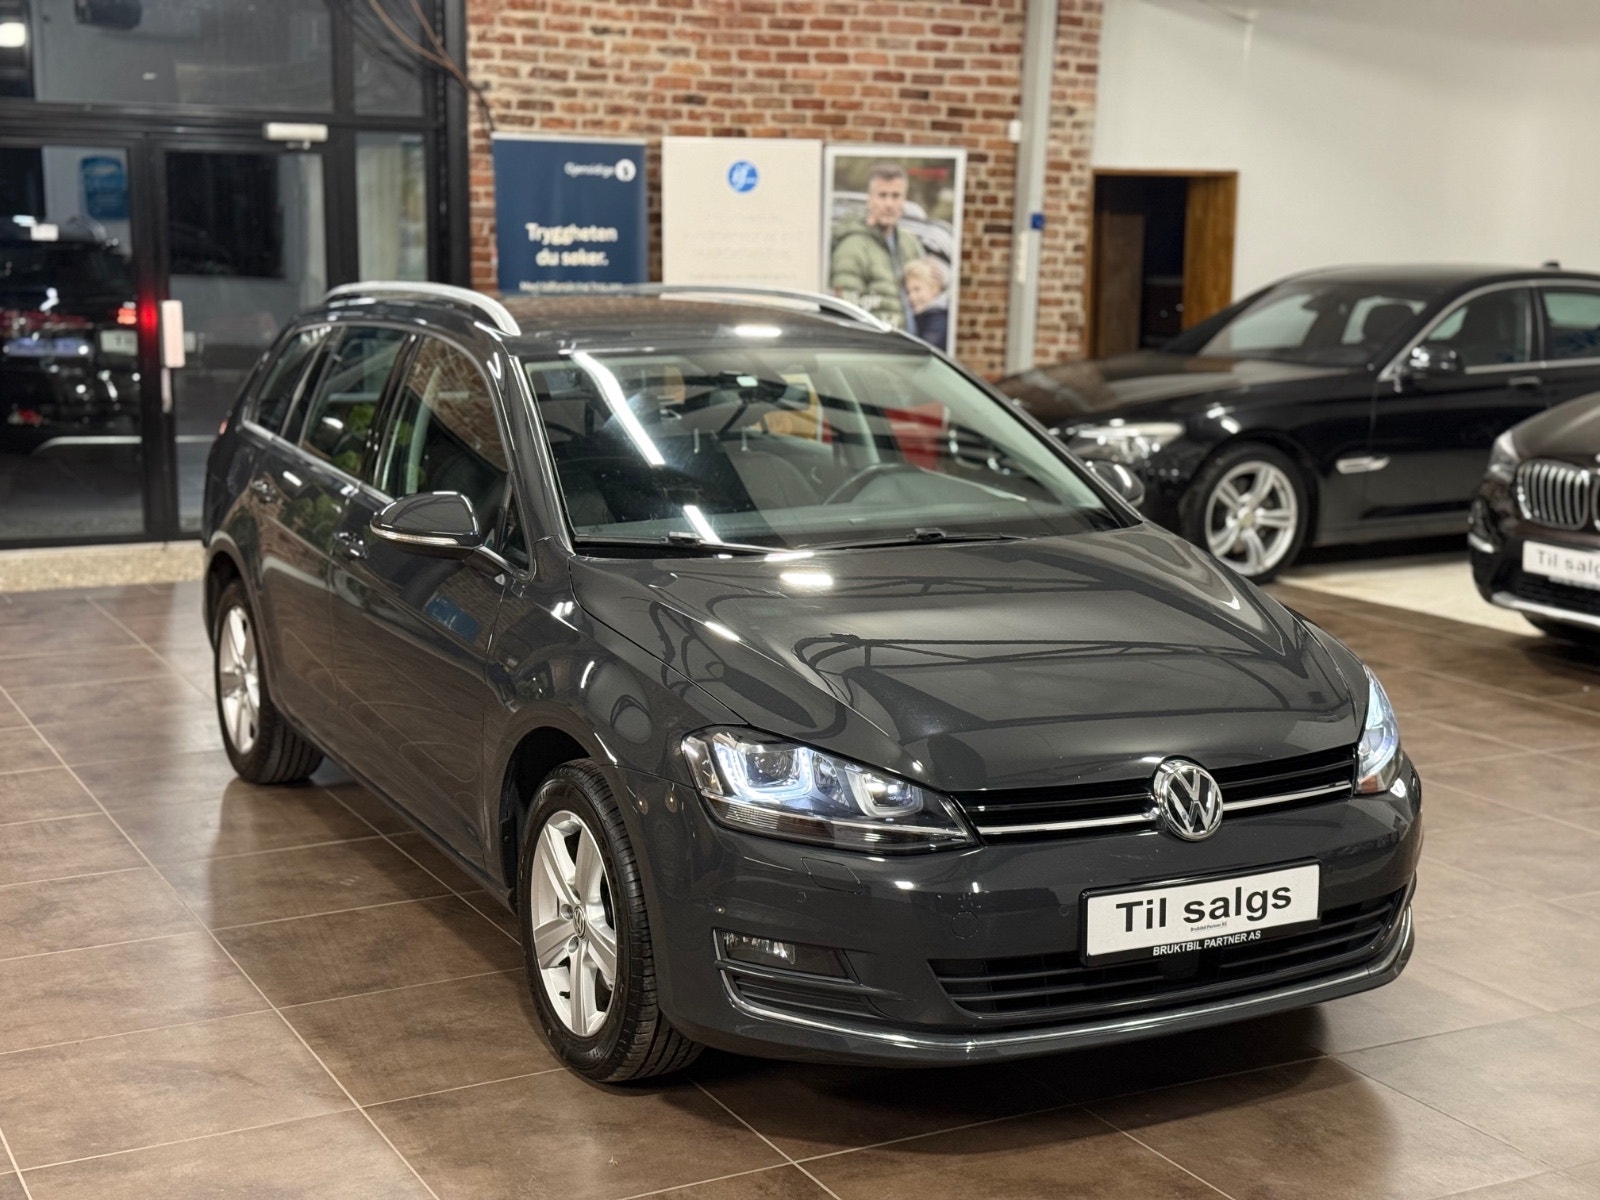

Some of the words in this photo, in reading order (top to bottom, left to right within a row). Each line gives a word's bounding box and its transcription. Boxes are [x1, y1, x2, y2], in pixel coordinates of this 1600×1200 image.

[525, 222, 619, 246] Tryggheten
[535, 248, 560, 267] du
[1538, 550, 1558, 567] Til
[1115, 897, 1167, 933] Til
[1183, 886, 1292, 924] salgs
[1152, 941, 1202, 956] BRUKTBIL
[1204, 932, 1247, 949] PARTNER
[1248, 930, 1262, 941] AS
